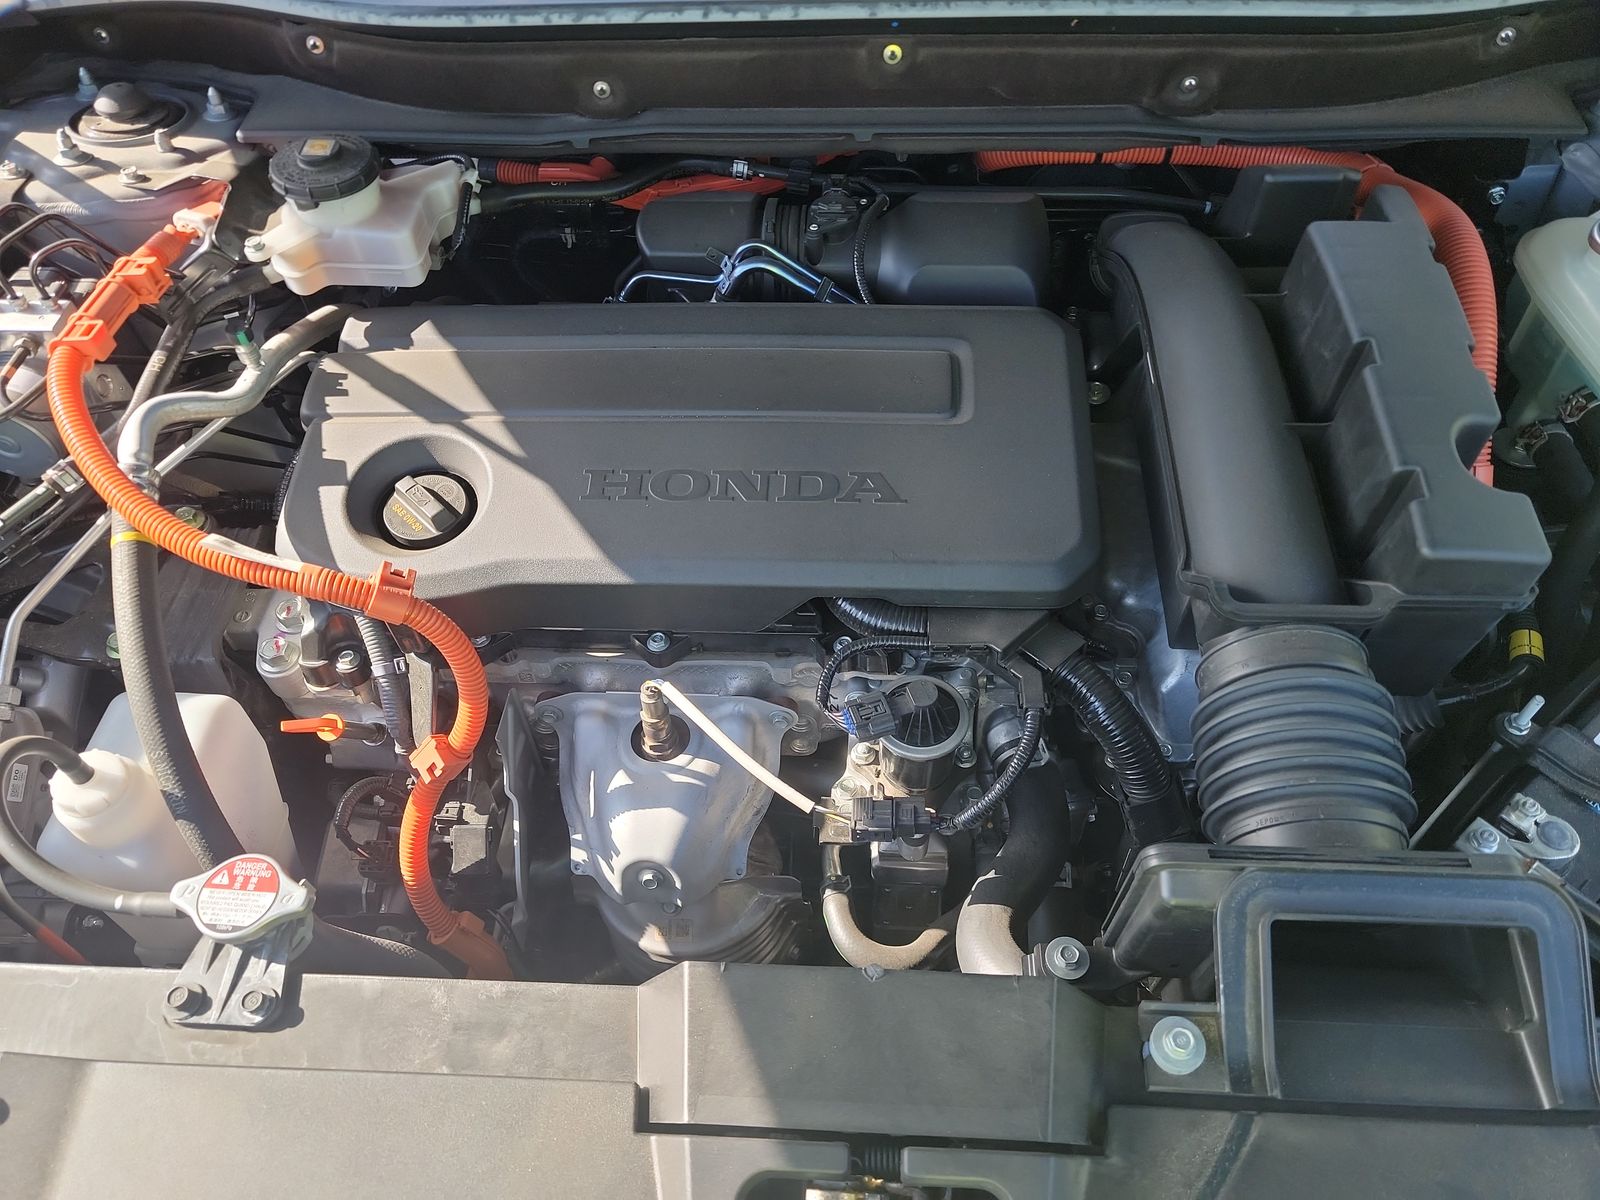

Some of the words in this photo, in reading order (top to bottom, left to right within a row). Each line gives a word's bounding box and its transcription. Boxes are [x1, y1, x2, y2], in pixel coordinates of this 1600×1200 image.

[578, 468, 908, 504] HONDA
[391, 502, 407, 518] SAE
[402, 511, 425, 534] 0W-20
[233, 868, 272, 878] WARNUNG
[235, 861, 268, 871] DANGER
